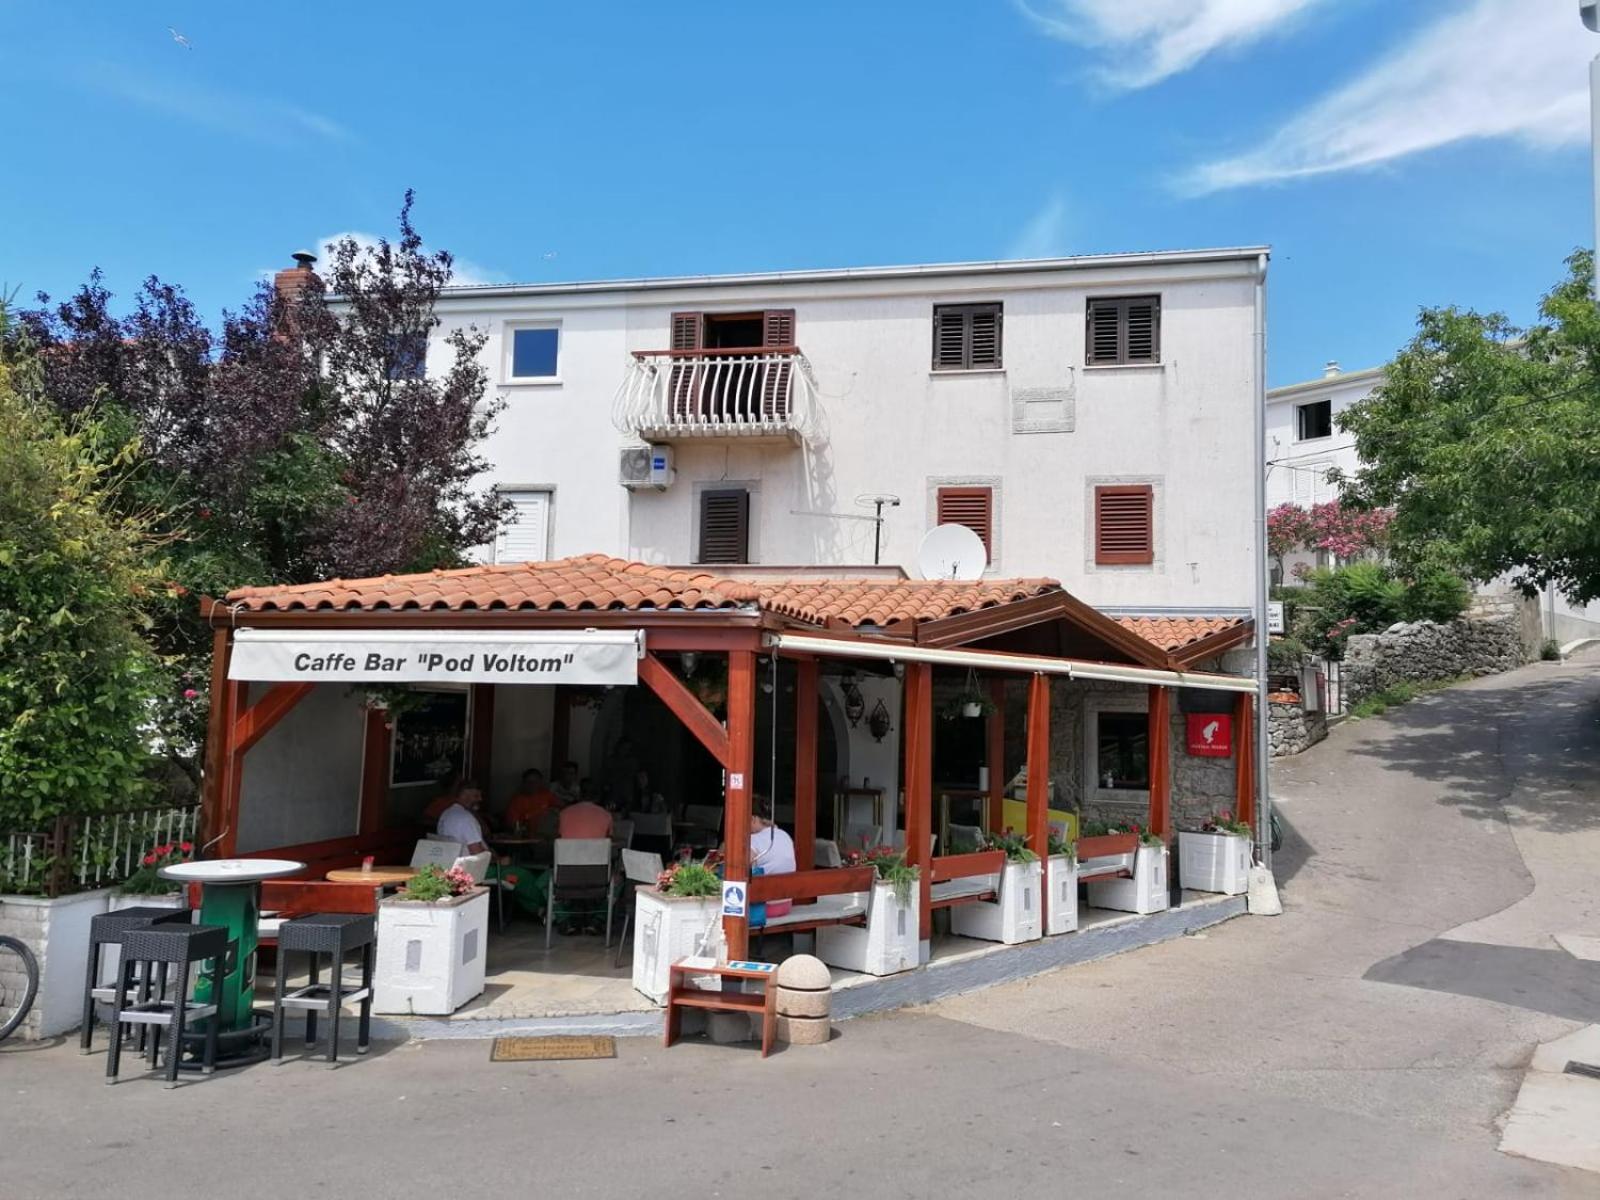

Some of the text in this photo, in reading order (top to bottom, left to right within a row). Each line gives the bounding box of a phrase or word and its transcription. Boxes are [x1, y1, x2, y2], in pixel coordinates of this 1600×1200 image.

[294, 653, 574, 672] Caffe Bar "Pod Voltom"
